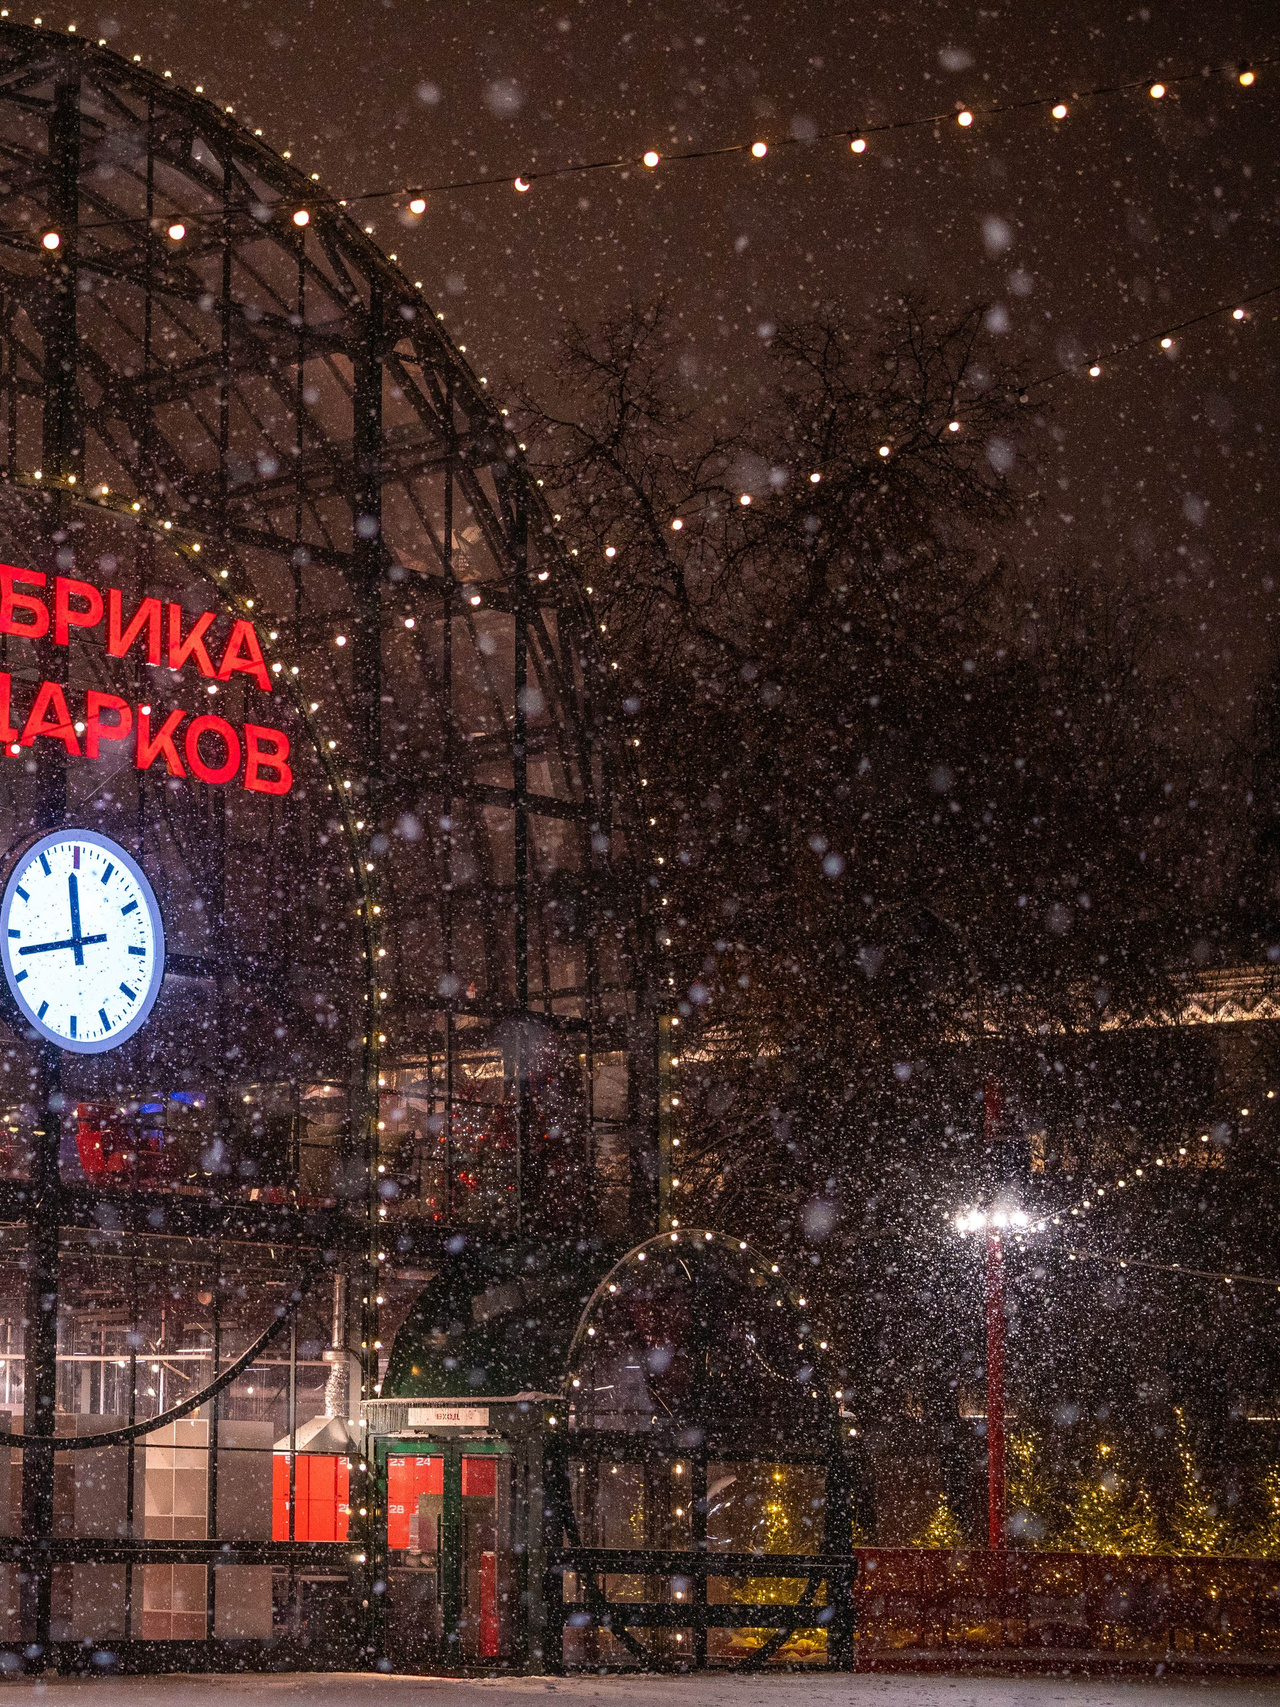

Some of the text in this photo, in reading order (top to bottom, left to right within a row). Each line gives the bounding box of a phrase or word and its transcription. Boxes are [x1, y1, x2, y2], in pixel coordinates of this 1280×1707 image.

[436, 1413, 460, 1421] ВХОД
[416, 1457, 431, 1466] 24
[389, 1505, 405, 1514] 28
